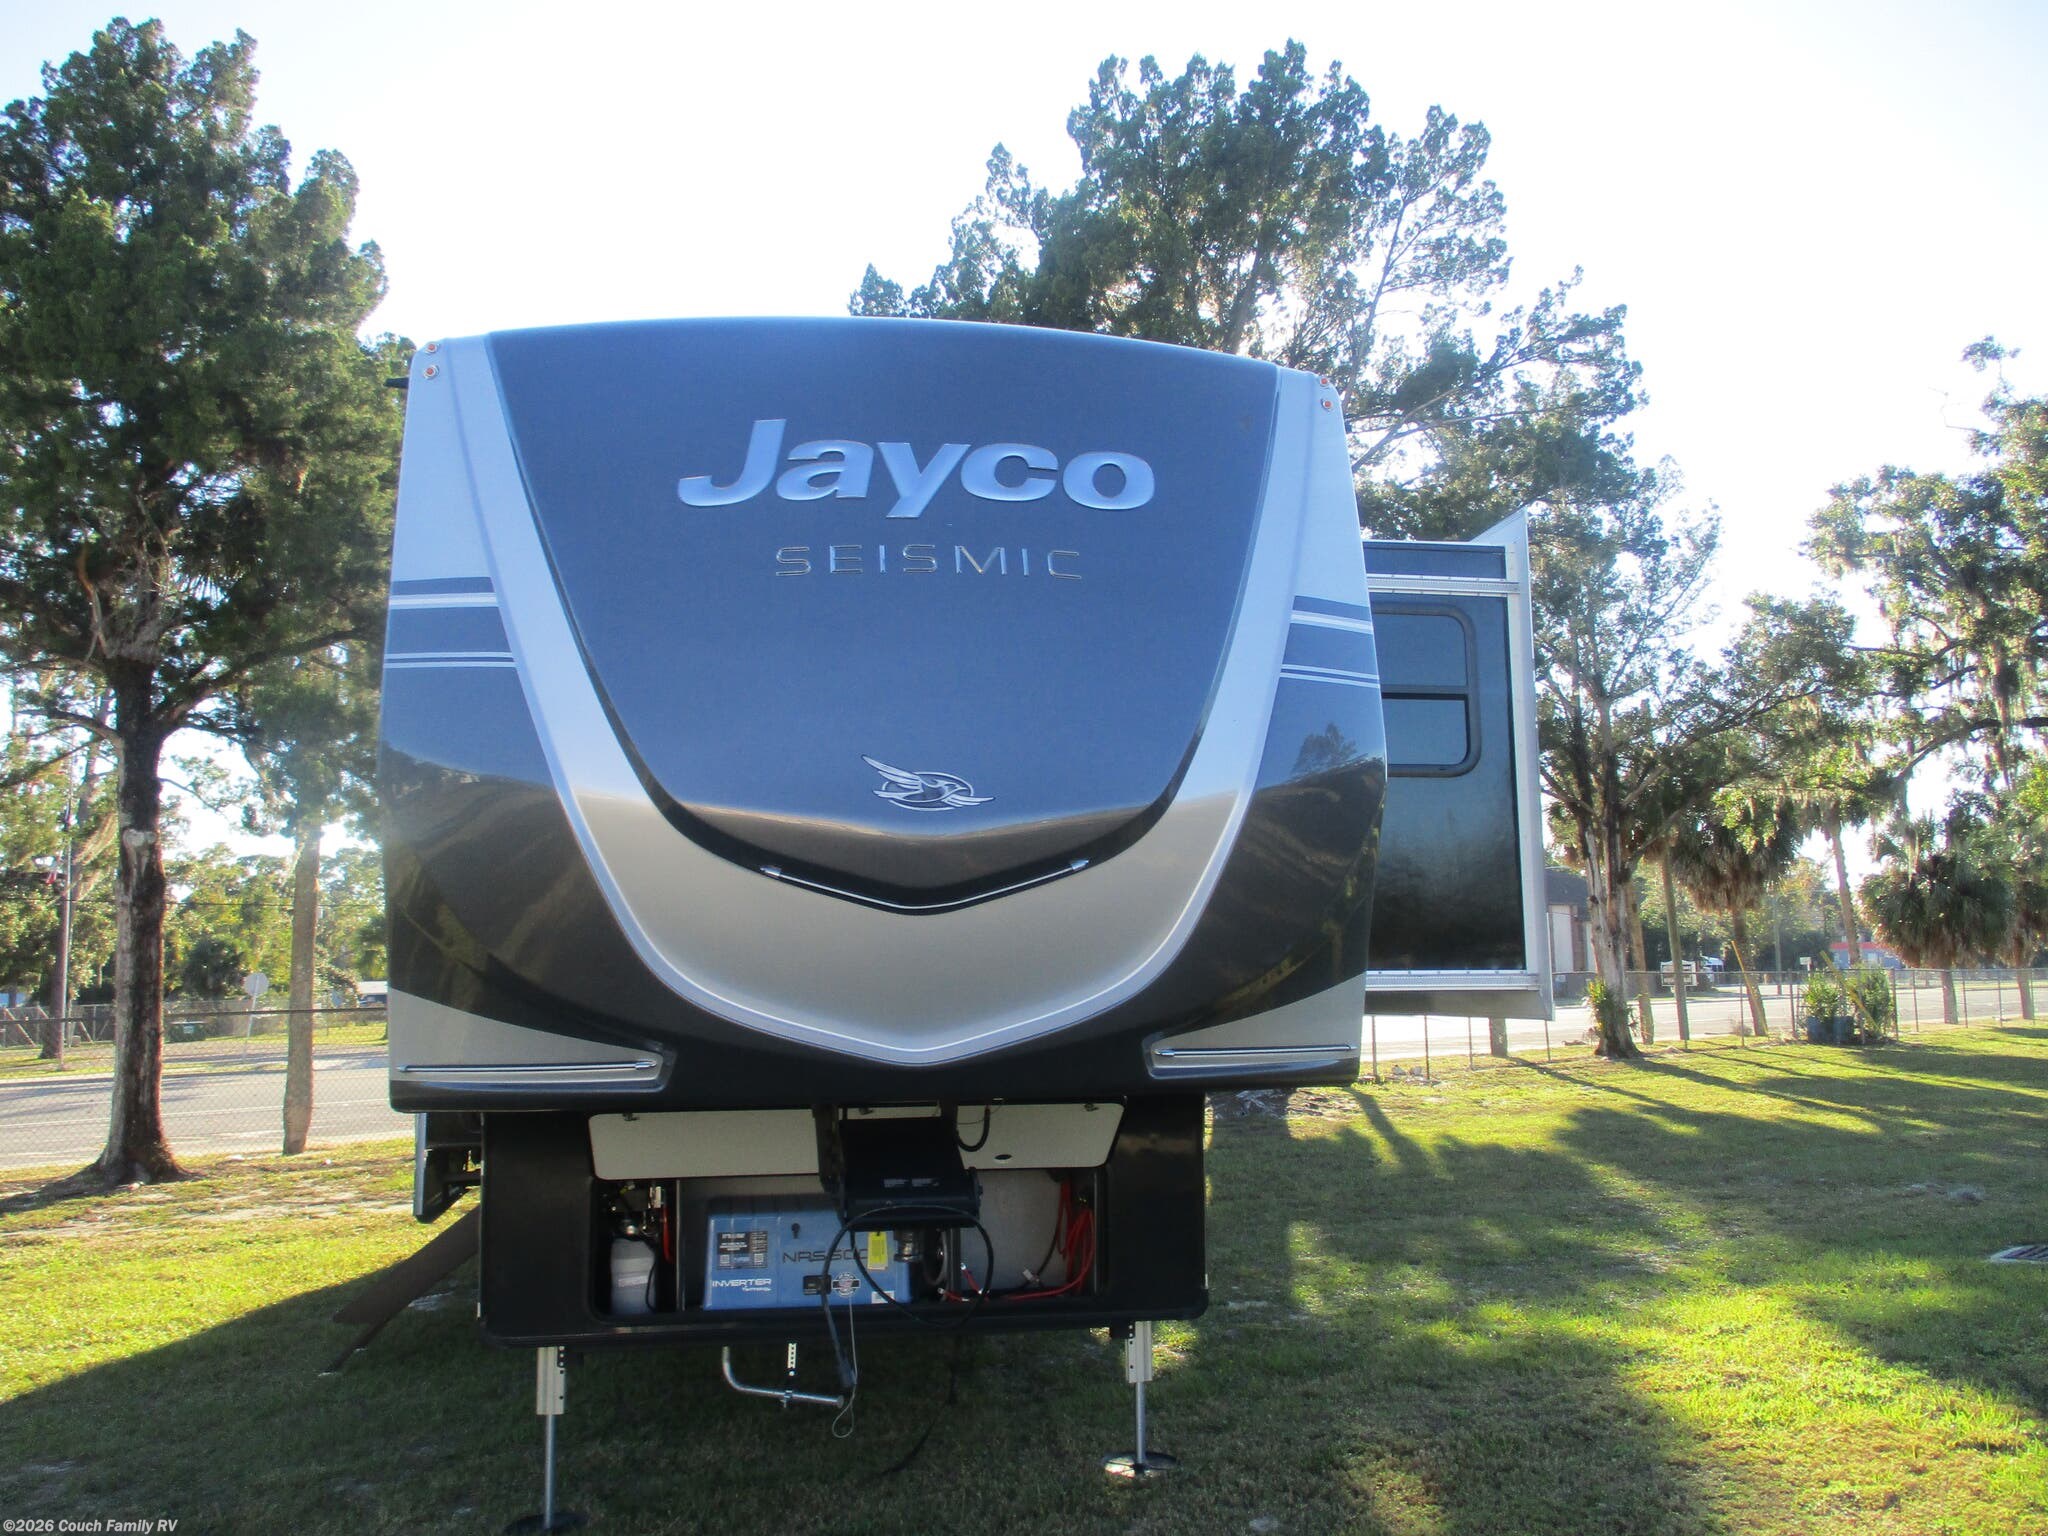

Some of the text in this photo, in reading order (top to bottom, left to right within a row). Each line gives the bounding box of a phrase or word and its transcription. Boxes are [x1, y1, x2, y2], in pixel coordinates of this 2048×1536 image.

[677, 418, 1155, 518] Jayco
[775, 544, 1082, 580] SEISMIC
[712, 1278, 772, 1287] INVERTER
